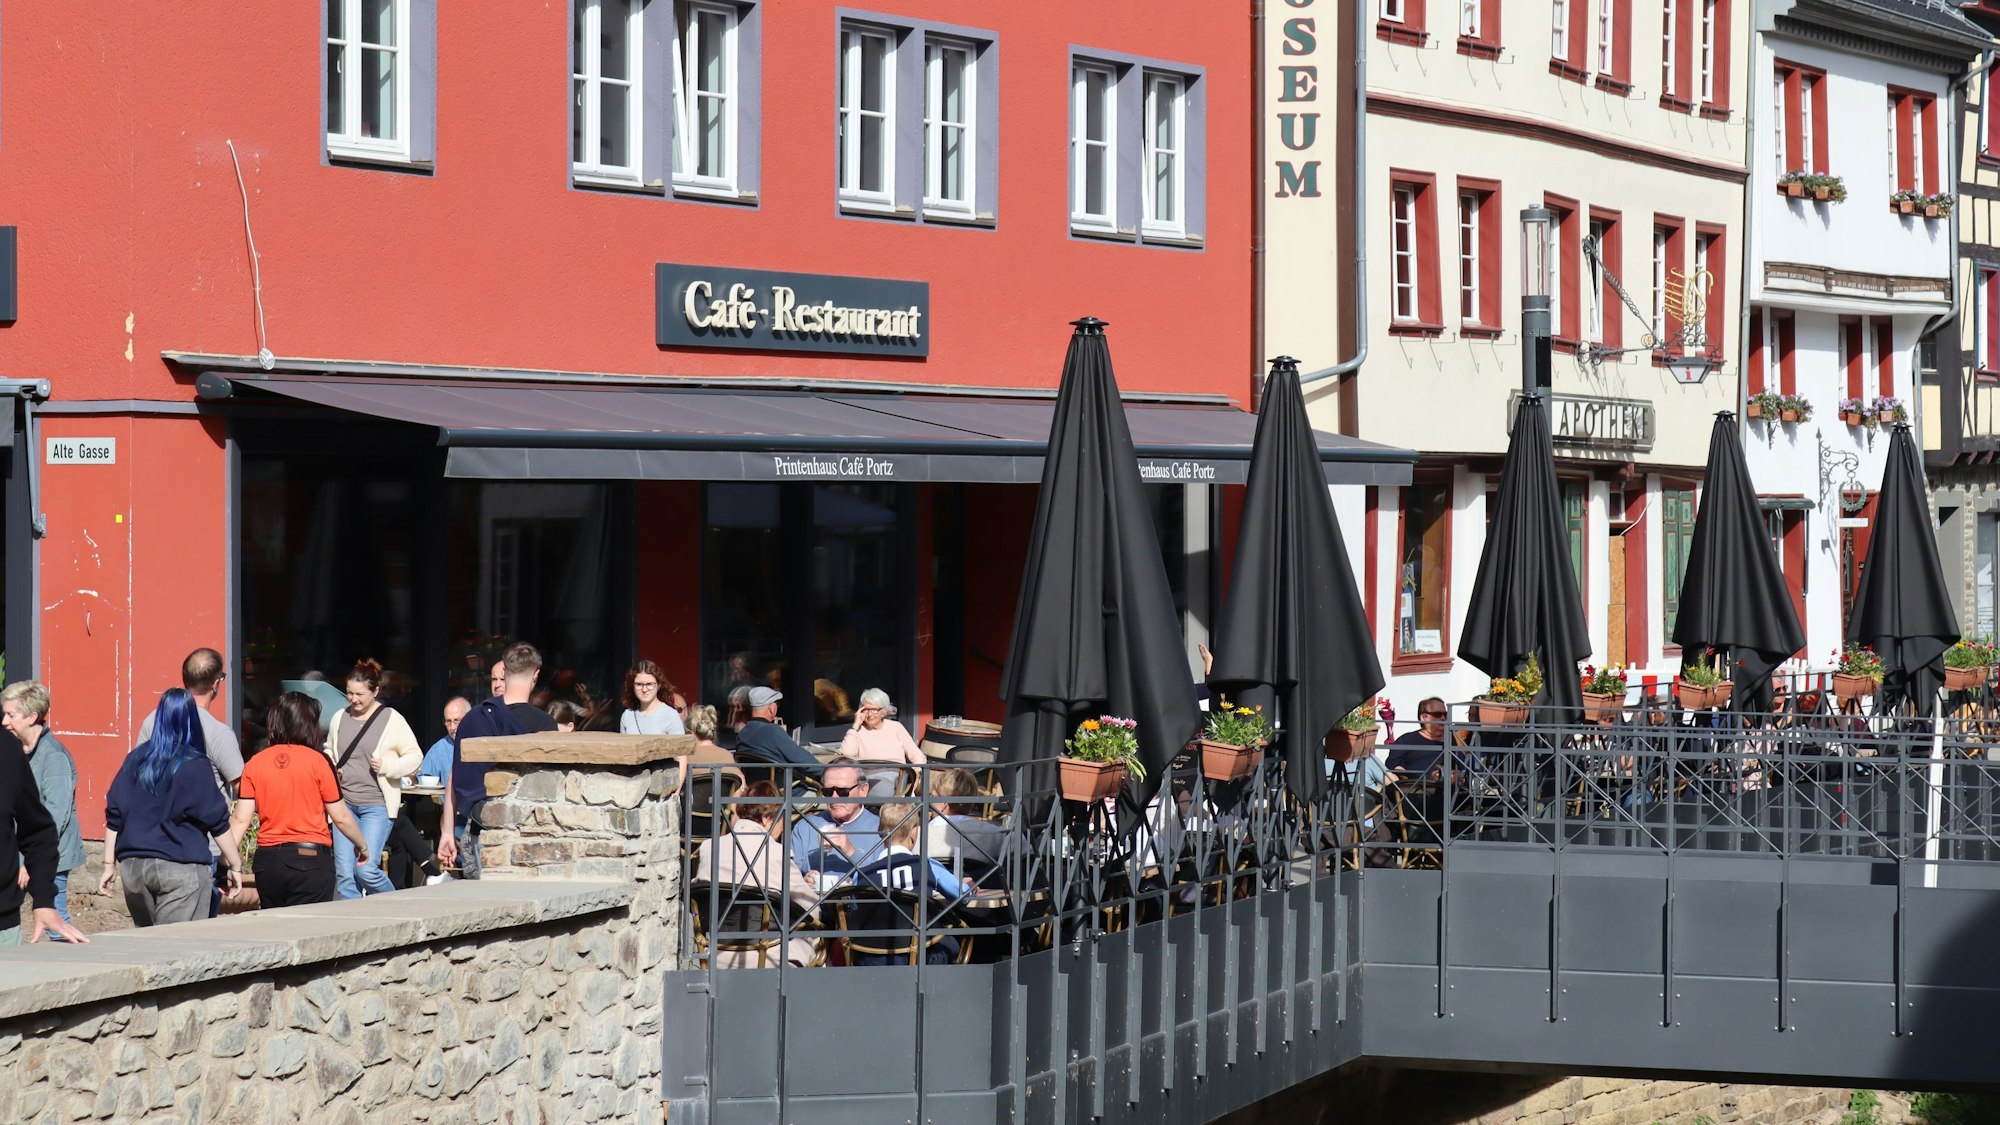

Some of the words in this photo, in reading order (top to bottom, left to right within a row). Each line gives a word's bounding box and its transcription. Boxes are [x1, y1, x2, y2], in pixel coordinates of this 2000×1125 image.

[1275, 0, 1321, 198] SEUM
[1559, 400, 1649, 440] APOTHEKE
[53, 443, 74, 459] Alte
[79, 443, 110, 459] Gasse
[774, 456, 838, 476] Printenhaus
[839, 456, 864, 476] Café
[866, 457, 894, 476] Portz
[1171, 461, 1192, 479] Café
[1192, 462, 1215, 479] Portz
[876, 865, 914, 891] 10
